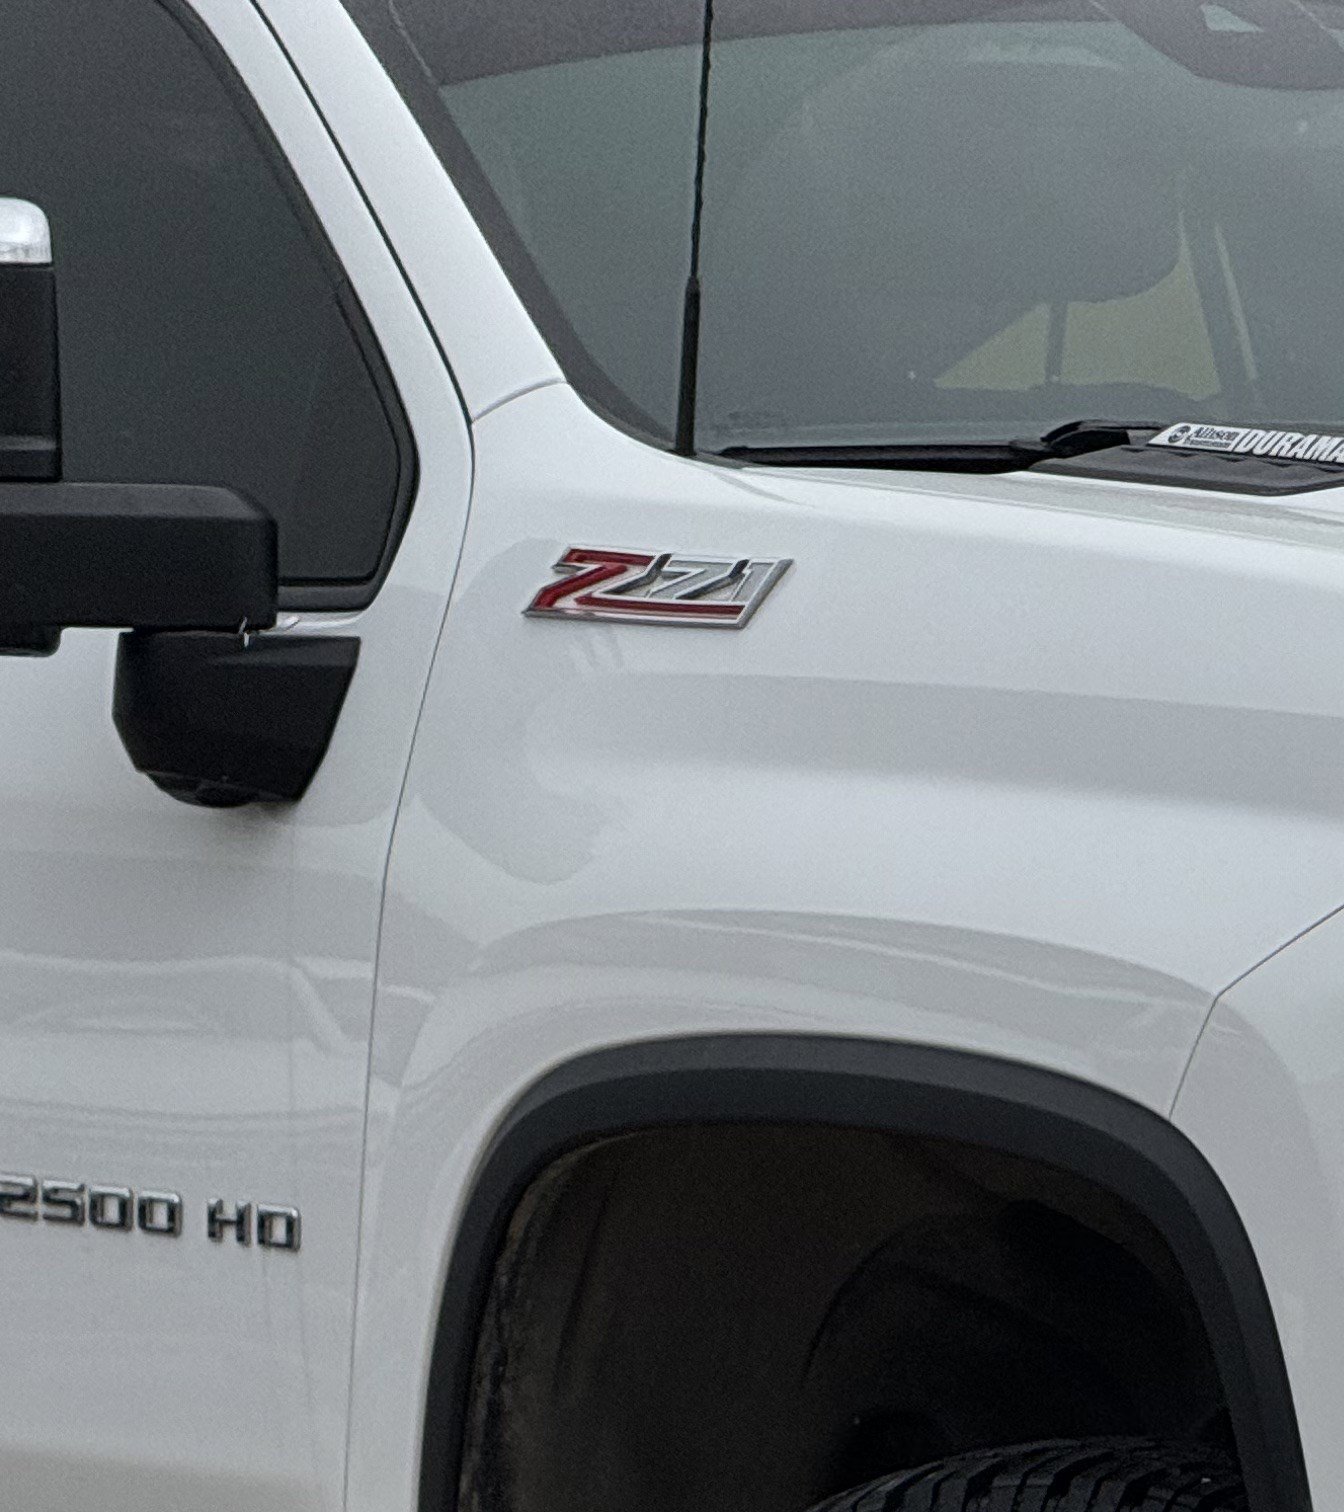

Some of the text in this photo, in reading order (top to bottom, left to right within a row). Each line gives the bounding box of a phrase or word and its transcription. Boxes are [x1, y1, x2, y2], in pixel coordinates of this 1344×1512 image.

[522, 546, 795, 630] Z71
[0, 1172, 302, 1252] 2500 HD
